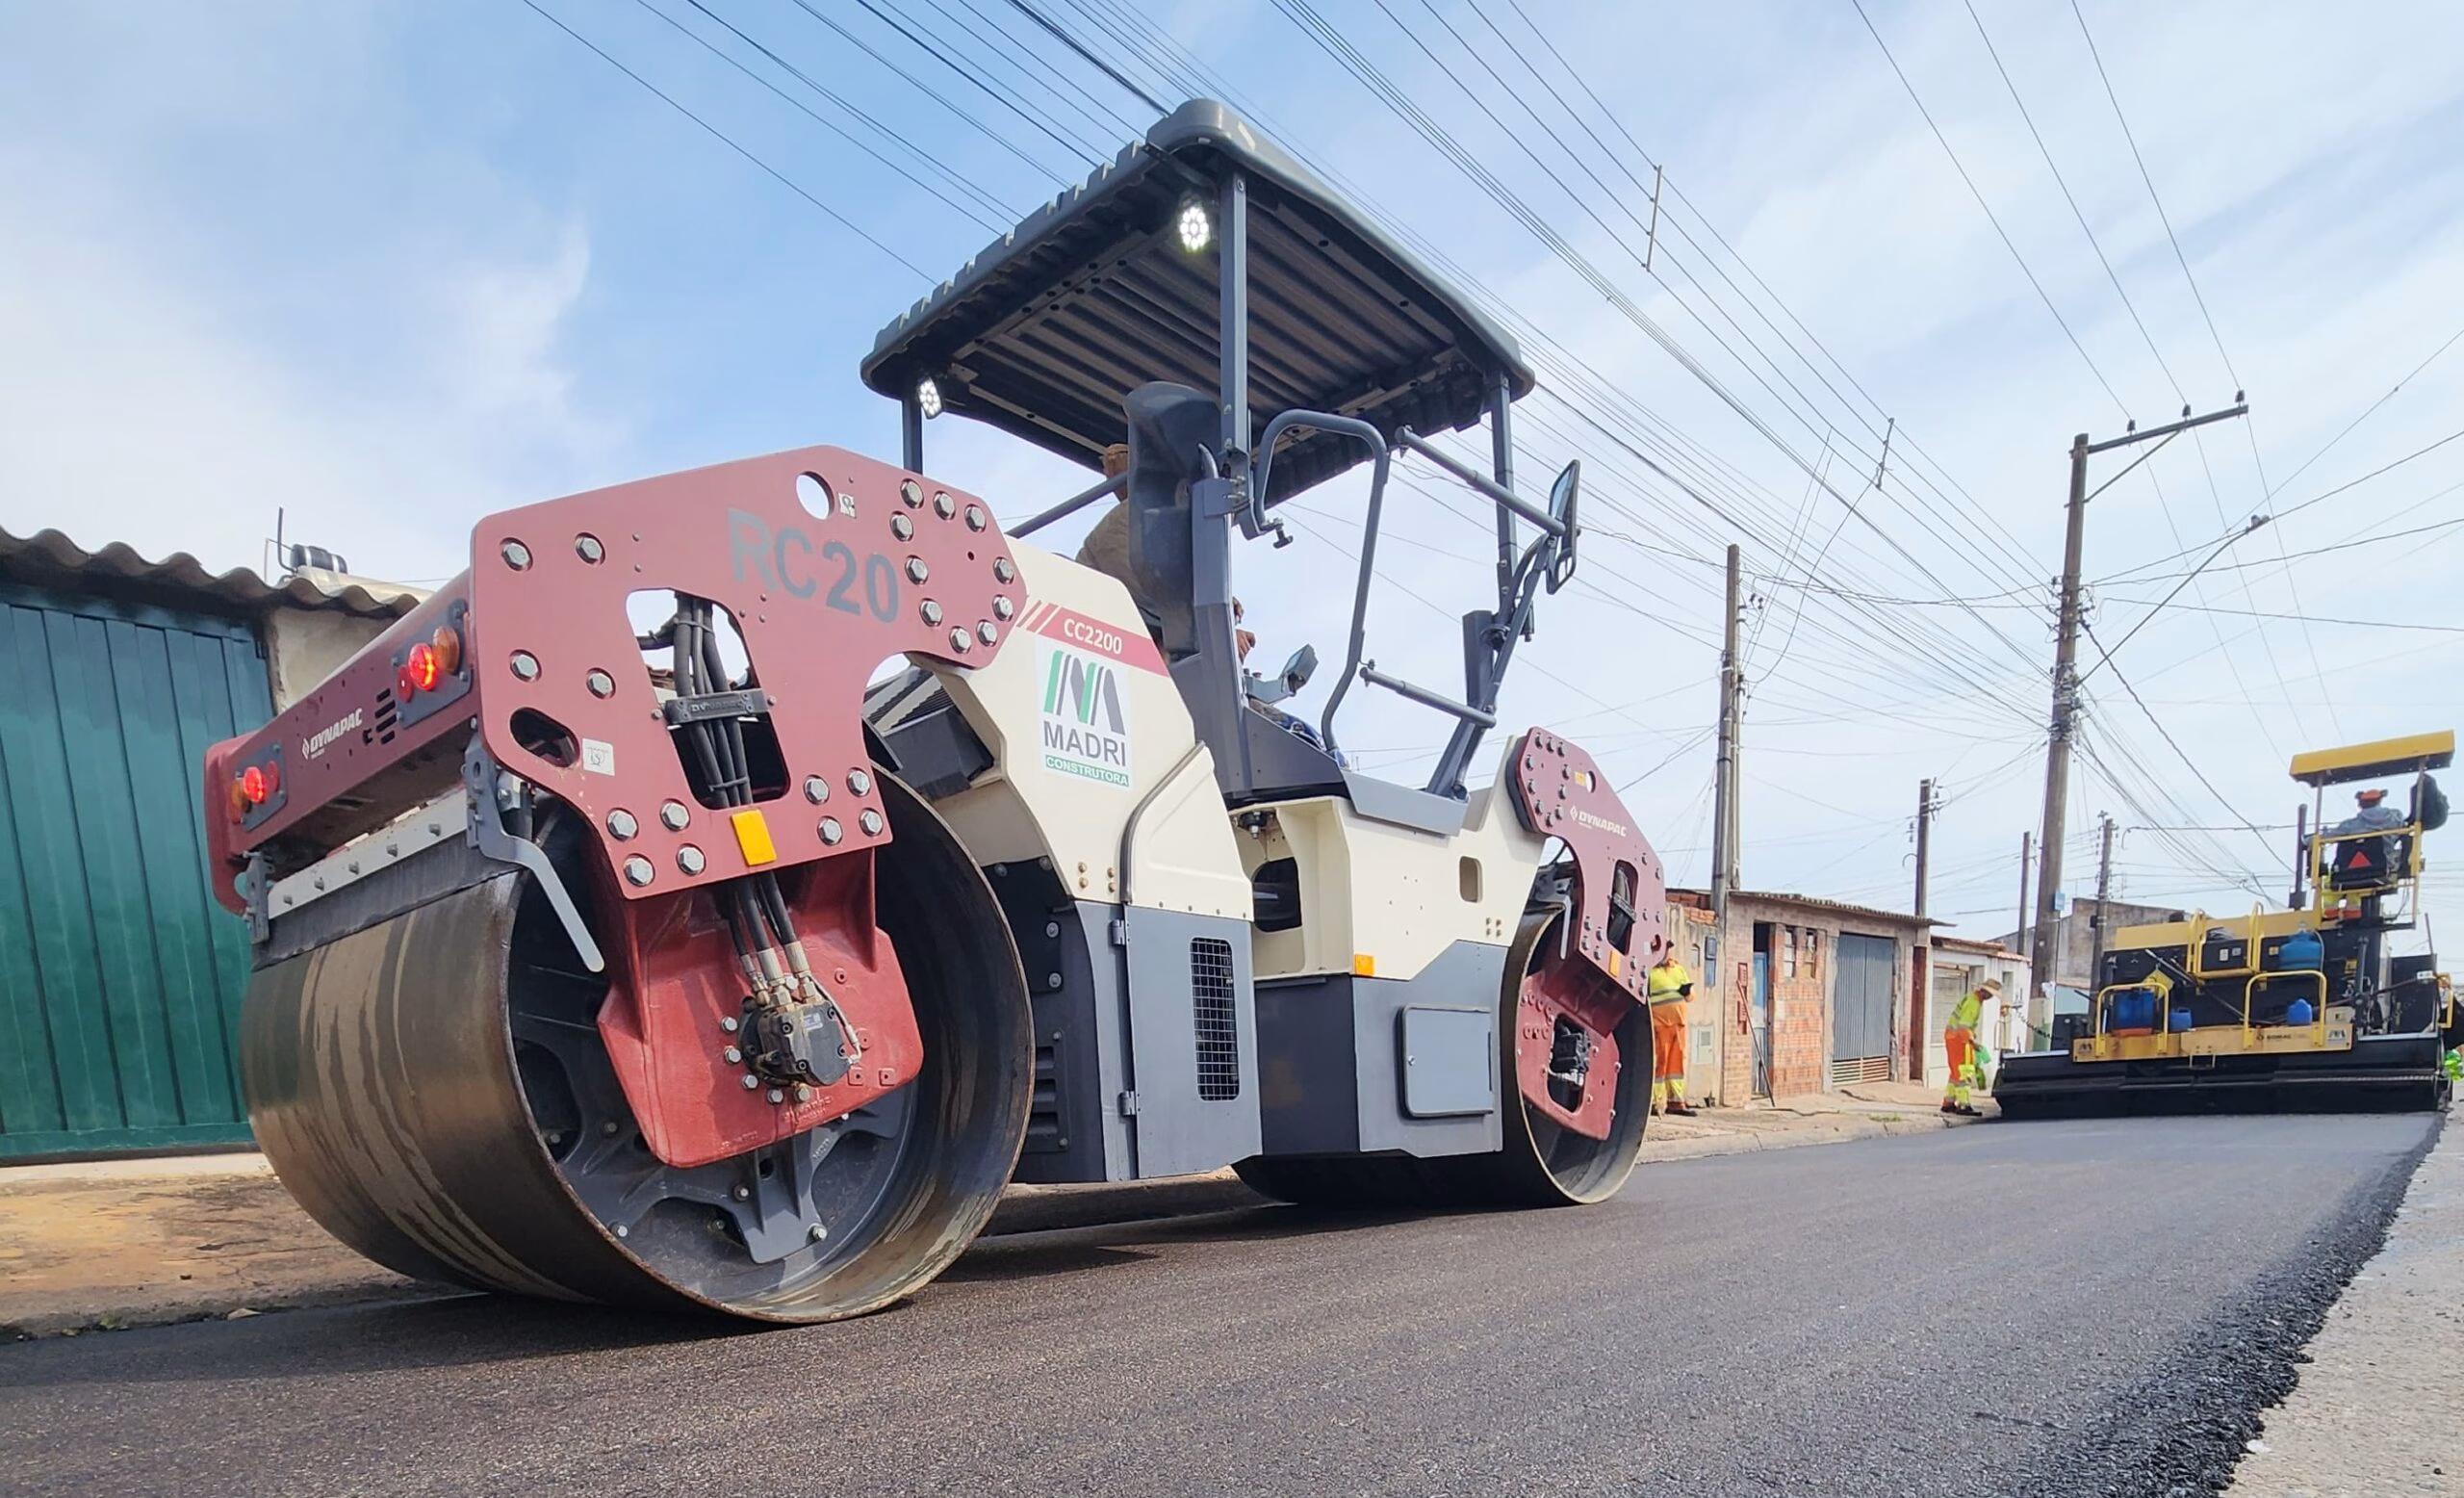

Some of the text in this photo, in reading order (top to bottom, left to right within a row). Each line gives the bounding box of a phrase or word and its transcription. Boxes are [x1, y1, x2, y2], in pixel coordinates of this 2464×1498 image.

[728, 507, 899, 624] RC20
[1064, 618, 1122, 655] CC2200
[310, 708, 363, 754] DYNAPAC
[1043, 720, 1126, 766] MADRI
[1046, 757, 1128, 786] CONSTRUTORA
[1578, 811, 1627, 838] DYNAPAC
